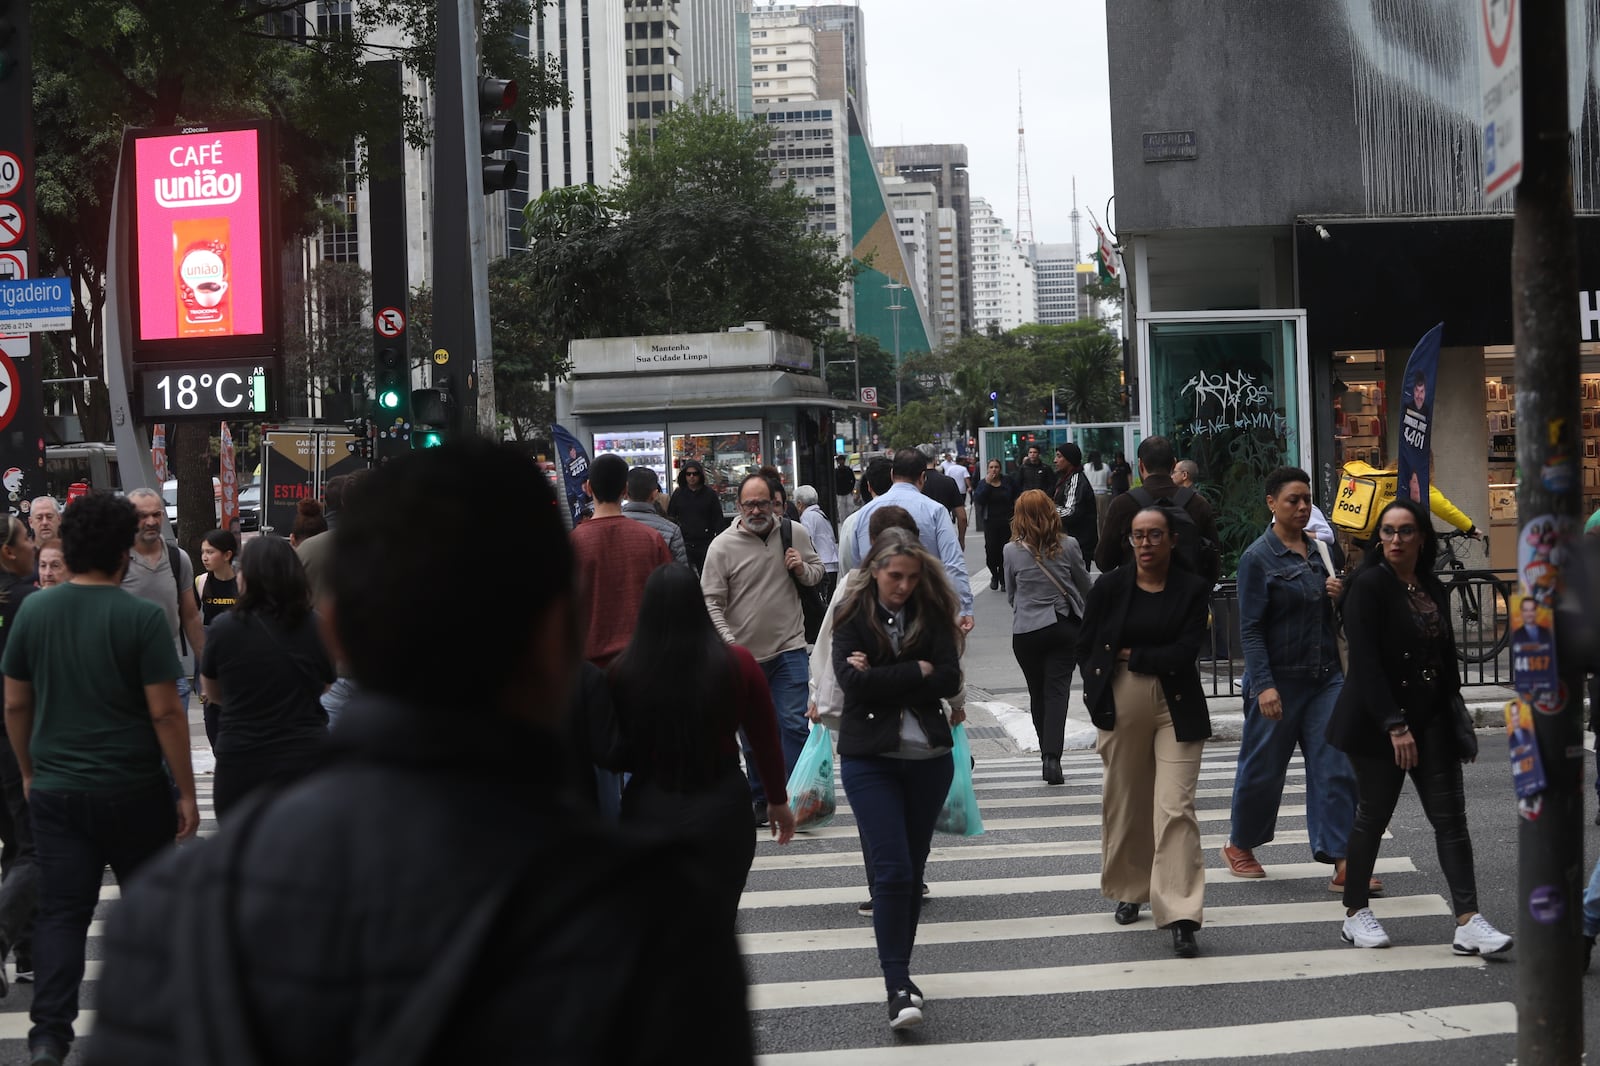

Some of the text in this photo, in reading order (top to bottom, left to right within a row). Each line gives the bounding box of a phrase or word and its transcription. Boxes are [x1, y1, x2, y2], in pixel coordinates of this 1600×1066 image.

[169, 140, 223, 167] CAFÉ
[0, 161, 15, 181] 0
[157, 170, 241, 204] união
[186, 259, 219, 277] união
[18, 322, 33, 330] 2124
[651, 344, 690, 352] Mantenha
[636, 353, 708, 363] Sua Cidade Limpa
[253, 366, 265, 376] AR
[156, 373, 243, 411] 18°C
[1342, 487, 1354, 499] 99
[1338, 500, 1362, 514] Food
[212, 597, 239, 605] OBJETIV
